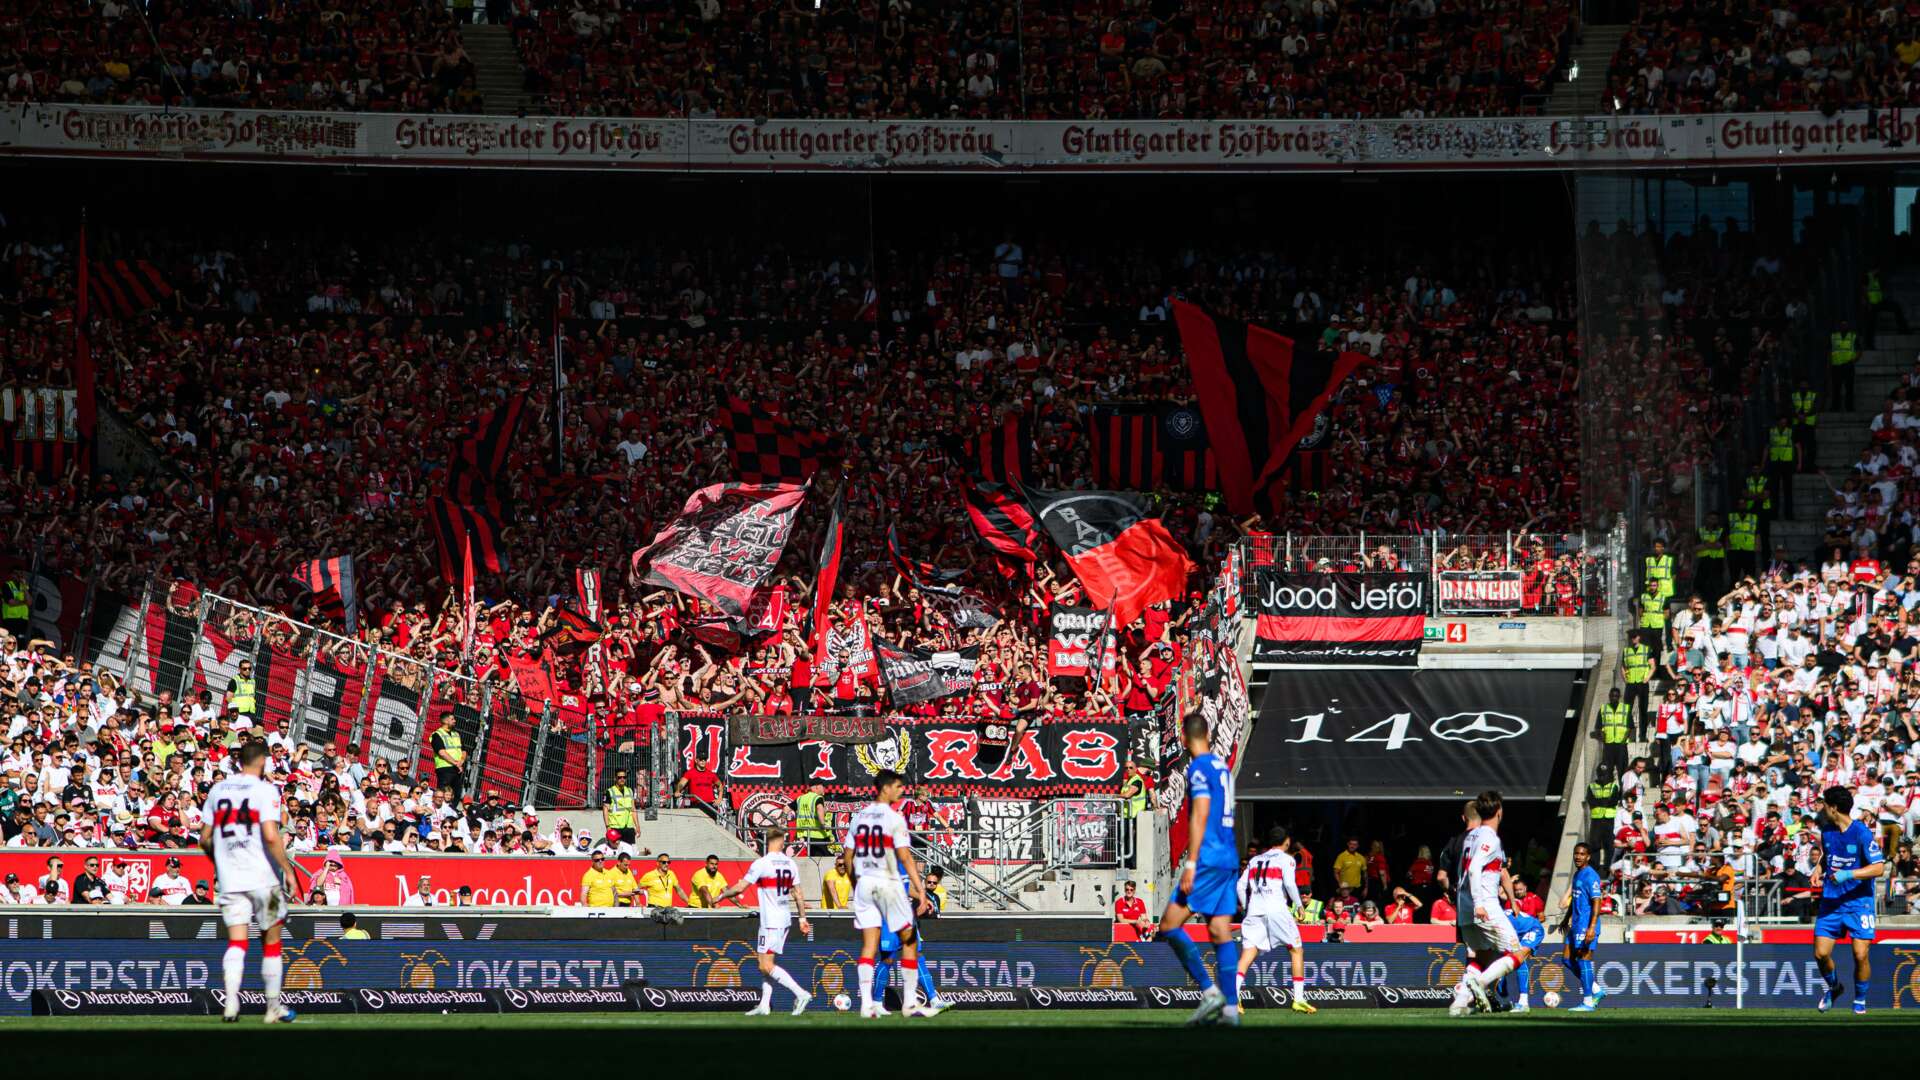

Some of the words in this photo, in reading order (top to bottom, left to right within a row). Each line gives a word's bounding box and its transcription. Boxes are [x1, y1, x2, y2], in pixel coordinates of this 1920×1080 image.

[729, 125, 878, 158] Stuttgarter
[884, 125, 993, 157] Hofbräu
[1061, 125, 1210, 160] Stuttgarter
[1262, 581, 1335, 609] Jood
[1351, 582, 1421, 610] Jeföl
[1442, 580, 1520, 600] DJANGOS
[1450, 624, 1463, 641] 4
[217, 798, 252, 838] 24
[977, 801, 1032, 816] WEST
[979, 817, 1032, 838] SIDE
[856, 823, 885, 858] 30
[978, 838, 1032, 859] BOYZ
[776, 869, 792, 896] 10
[1255, 860, 1271, 887] 11
[81, 990, 192, 1005] Mercedes-Benz
[382, 989, 487, 1004] Mercedes-Benz
[527, 989, 627, 1004] Mercedes-Benz
[669, 988, 760, 1003] Mercedes-Benz
[1050, 988, 1137, 1002] Mercedes-Benz
